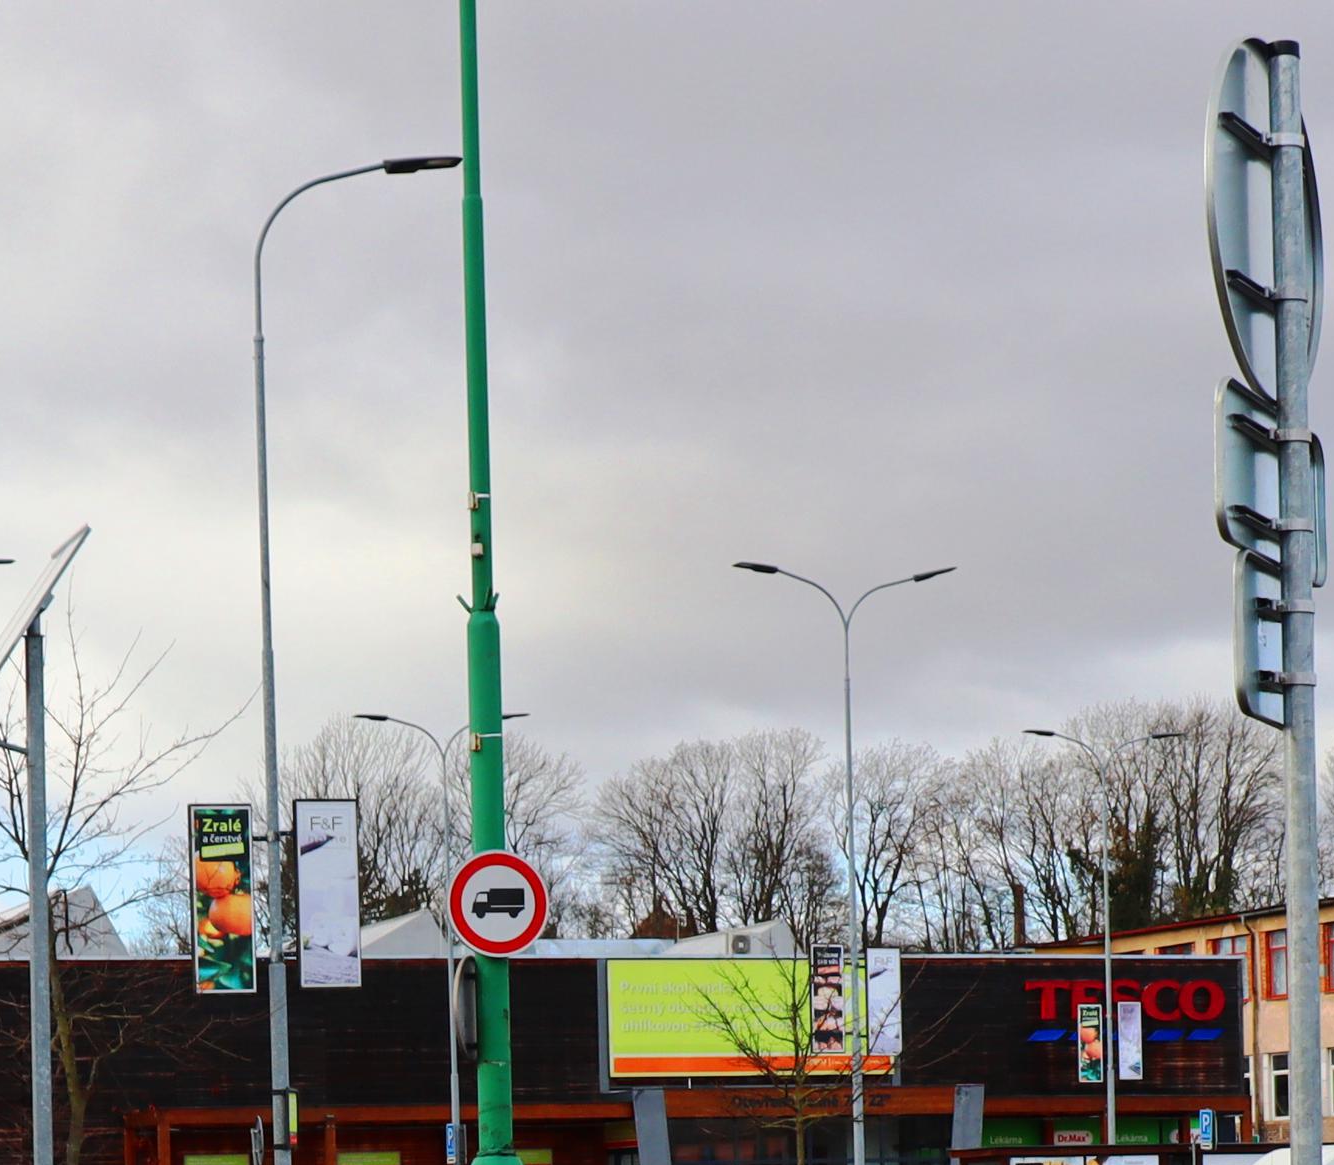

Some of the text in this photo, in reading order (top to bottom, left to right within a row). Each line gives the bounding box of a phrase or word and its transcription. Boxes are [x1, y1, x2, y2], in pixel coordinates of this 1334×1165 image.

[202, 817, 242, 833] Zralé
[310, 815, 344, 831] F&F
[202, 835, 209, 843] a
[1024, 979, 1226, 1021] TESCO
[1202, 1114, 1210, 1133] P
[1058, 1134, 1086, 1143] Dr.Max
